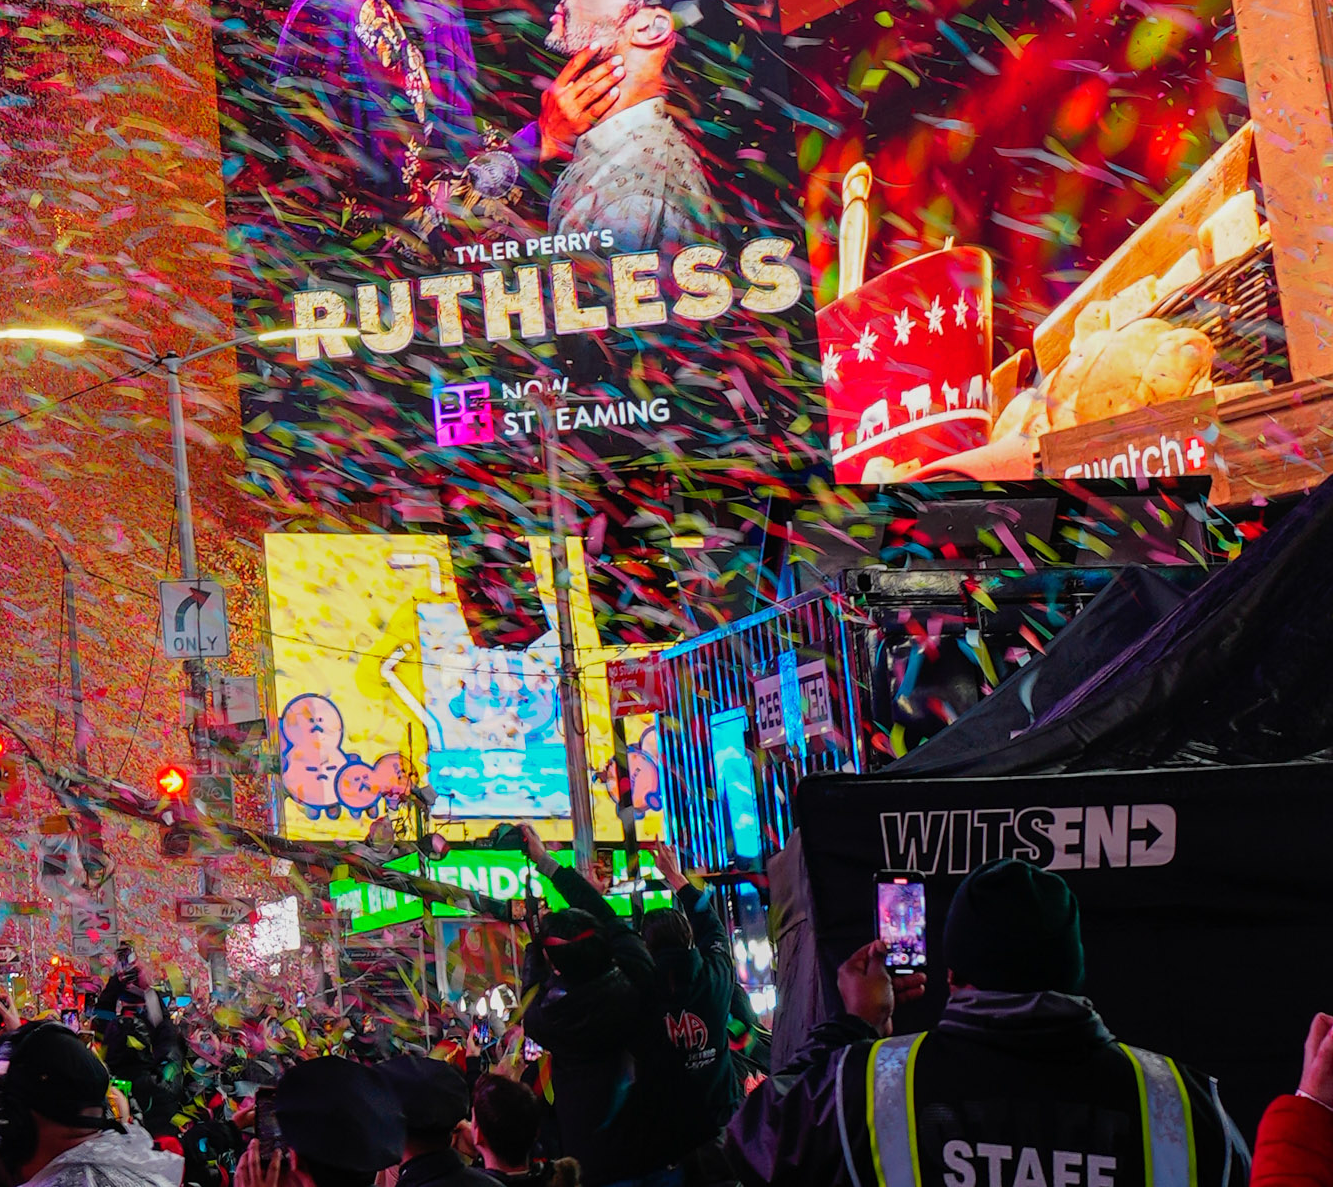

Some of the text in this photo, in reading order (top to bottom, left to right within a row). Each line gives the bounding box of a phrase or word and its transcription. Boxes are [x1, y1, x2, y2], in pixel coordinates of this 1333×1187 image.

[454, 229, 615, 265] TYLER PERRY'S
[292, 236, 802, 362] RUTHLESS
[503, 398, 671, 437] STEAMING
[173, 635, 219, 652] ONLY
[879, 806, 1177, 875] WITSEND
[186, 904, 244, 918] ONE WAY
[942, 1139, 1118, 1187] STAFF
